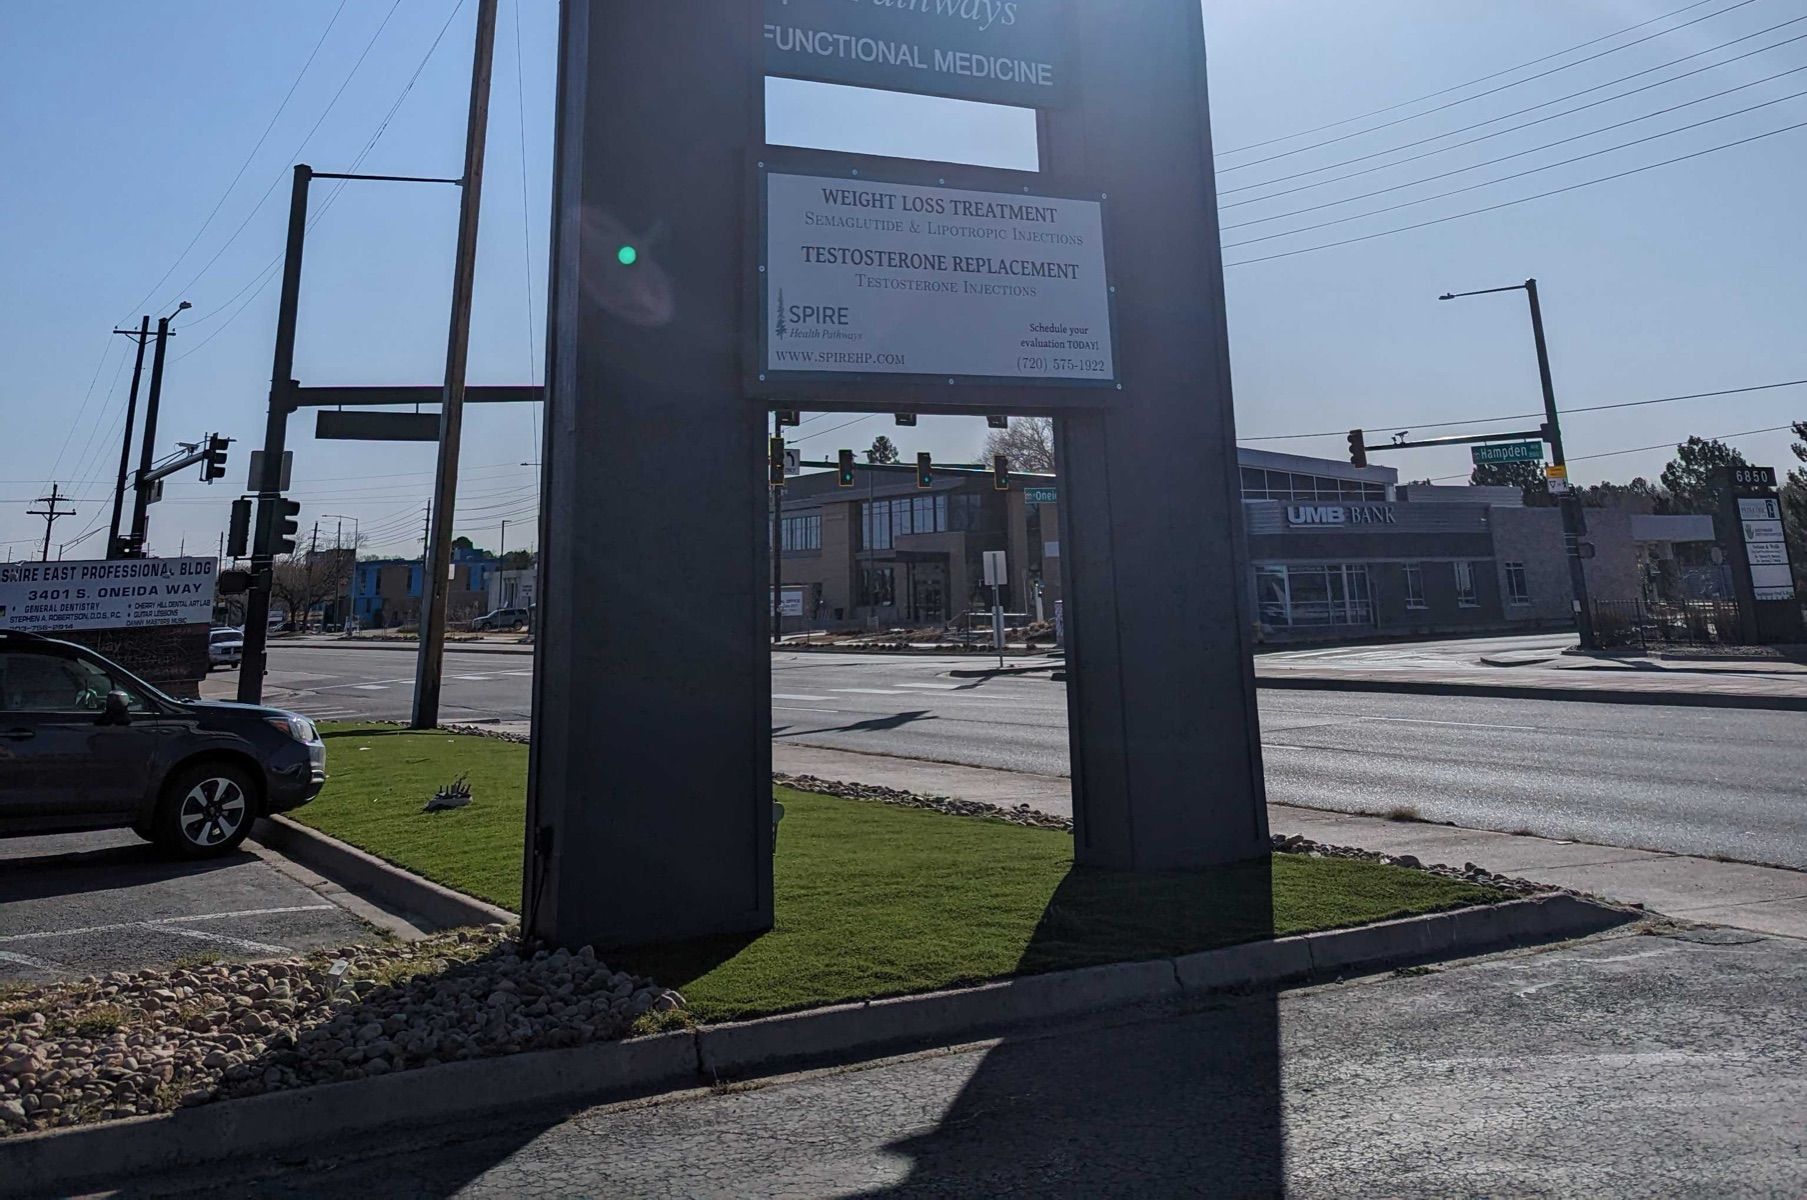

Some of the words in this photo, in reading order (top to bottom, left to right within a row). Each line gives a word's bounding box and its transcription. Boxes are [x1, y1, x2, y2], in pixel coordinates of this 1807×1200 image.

[935, 50, 1053, 86] MEDICINE
[822, 187, 896, 210] WEIGHT
[901, 195, 945, 215] LOSS
[950, 200, 1058, 224] TREATMENT
[804, 211, 904, 234] SEMAGLUTIDE
[908, 221, 921, 234] &
[927, 222, 1007, 240] LIPOTROPIC
[1012, 228, 1084, 246] INJECTIONS
[801, 246, 948, 272] TESTOSTERONE
[952, 256, 1079, 280] REPLACEMENT
[855, 273, 957, 293] TESTOSTERONE
[963, 280, 1037, 297] INJECTIONS
[789, 305, 849, 326] SPIRE
[789, 327, 820, 340] Health
[821, 329, 864, 343] Pathways
[1029, 322, 1067, 335] Schedule
[1069, 325, 1088, 336] your
[1020, 338, 1065, 349] evaluation
[1066, 339, 1099, 351] TODAY!
[775, 350, 905, 366] WWW.SPIREHP.COM
[1016, 356, 1049, 373] (720)
[1052, 356, 1105, 373] 575-1922
[1480, 445, 1528, 461] Hampden
[1736, 470, 1768, 483] 6850
[1287, 506, 1345, 524] UMB
[1350, 506, 1397, 524] BANK
[43, 565, 78, 581] EAST
[81, 562, 175, 580] PROFESSIONAL
[180, 561, 212, 576] BLDG
[28, 589, 70, 601] 3401
[76, 588, 91, 599] S.
[98, 585, 159, 599] ONEIDA
[166, 583, 203, 595] WAY
[25, 604, 58, 614] GENERAL
[60, 602, 100, 613] DENTISTRY
